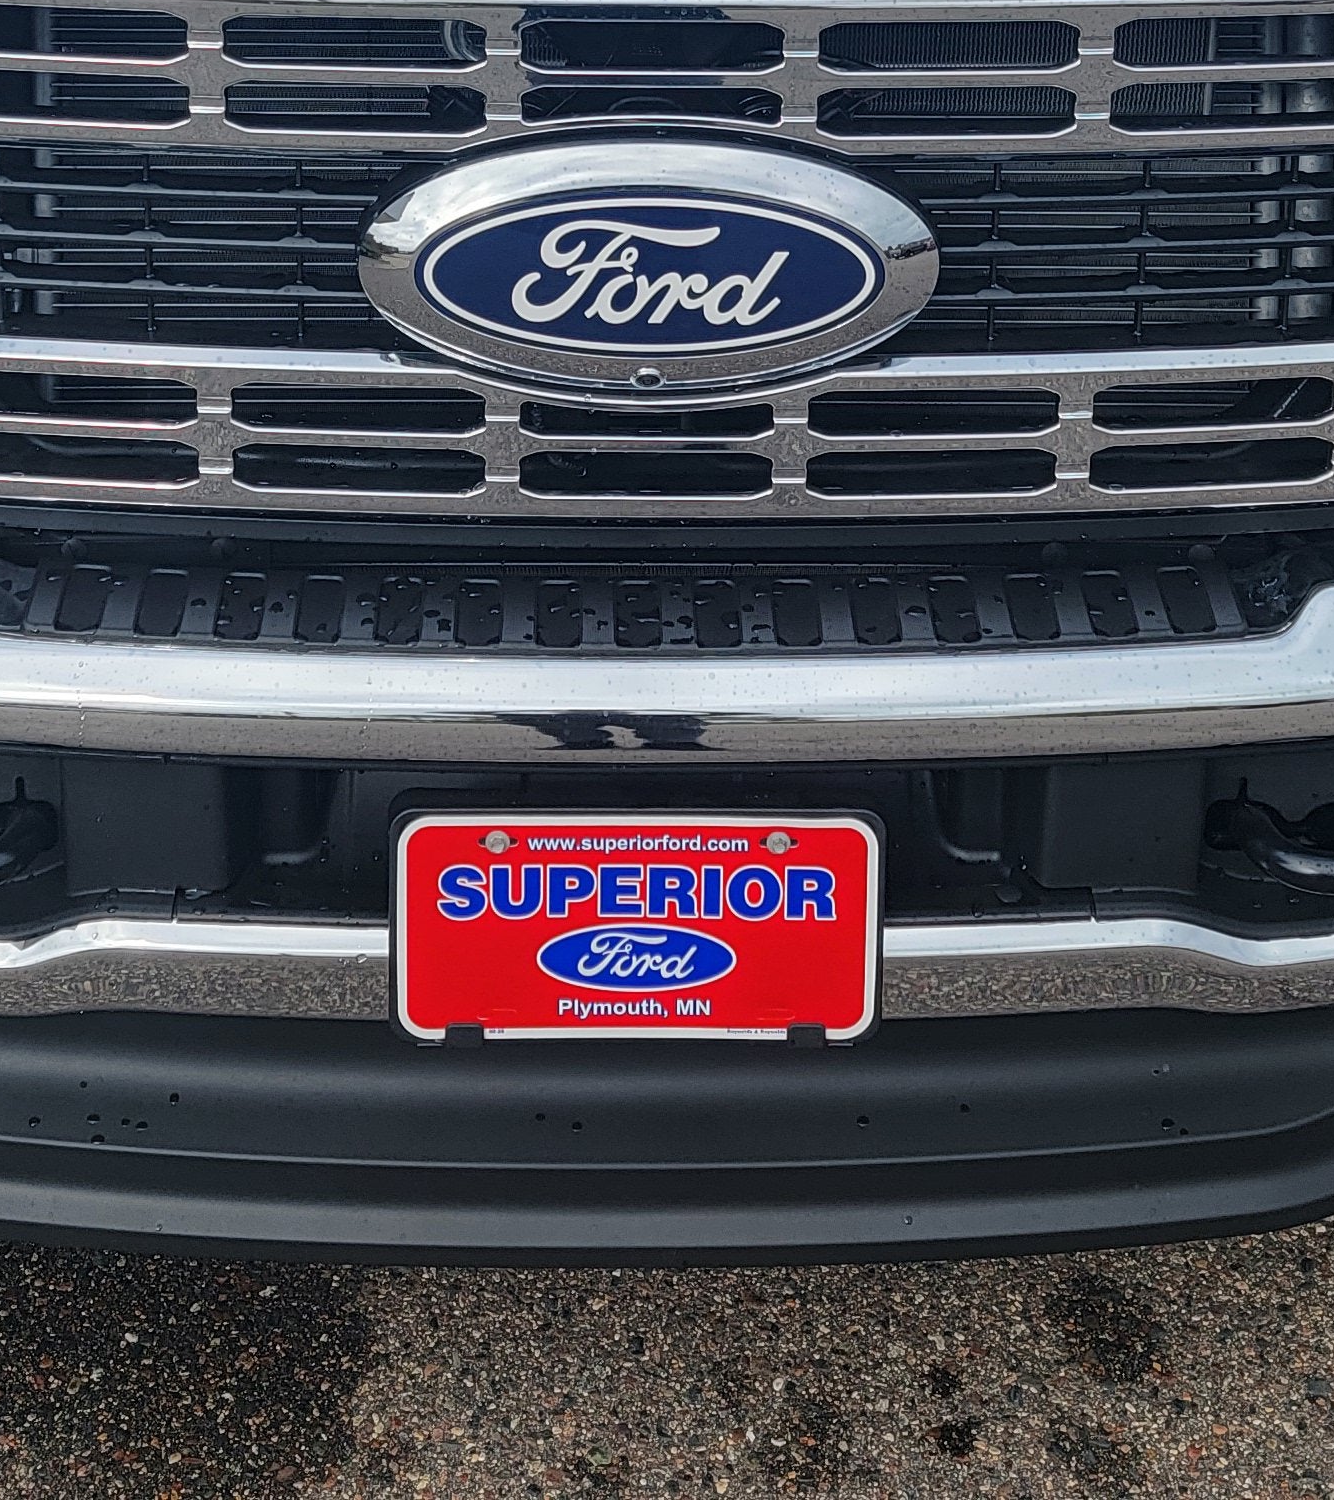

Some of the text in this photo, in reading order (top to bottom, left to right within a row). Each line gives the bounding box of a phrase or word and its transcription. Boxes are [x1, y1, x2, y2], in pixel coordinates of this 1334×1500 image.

[511, 219, 789, 326] Ford
[527, 835, 750, 854] www.superiorford.com
[436, 863, 837, 921] SUPERIOR
[576, 932, 696, 980] Ford
[558, 999, 712, 1021] Plymouth, MN
